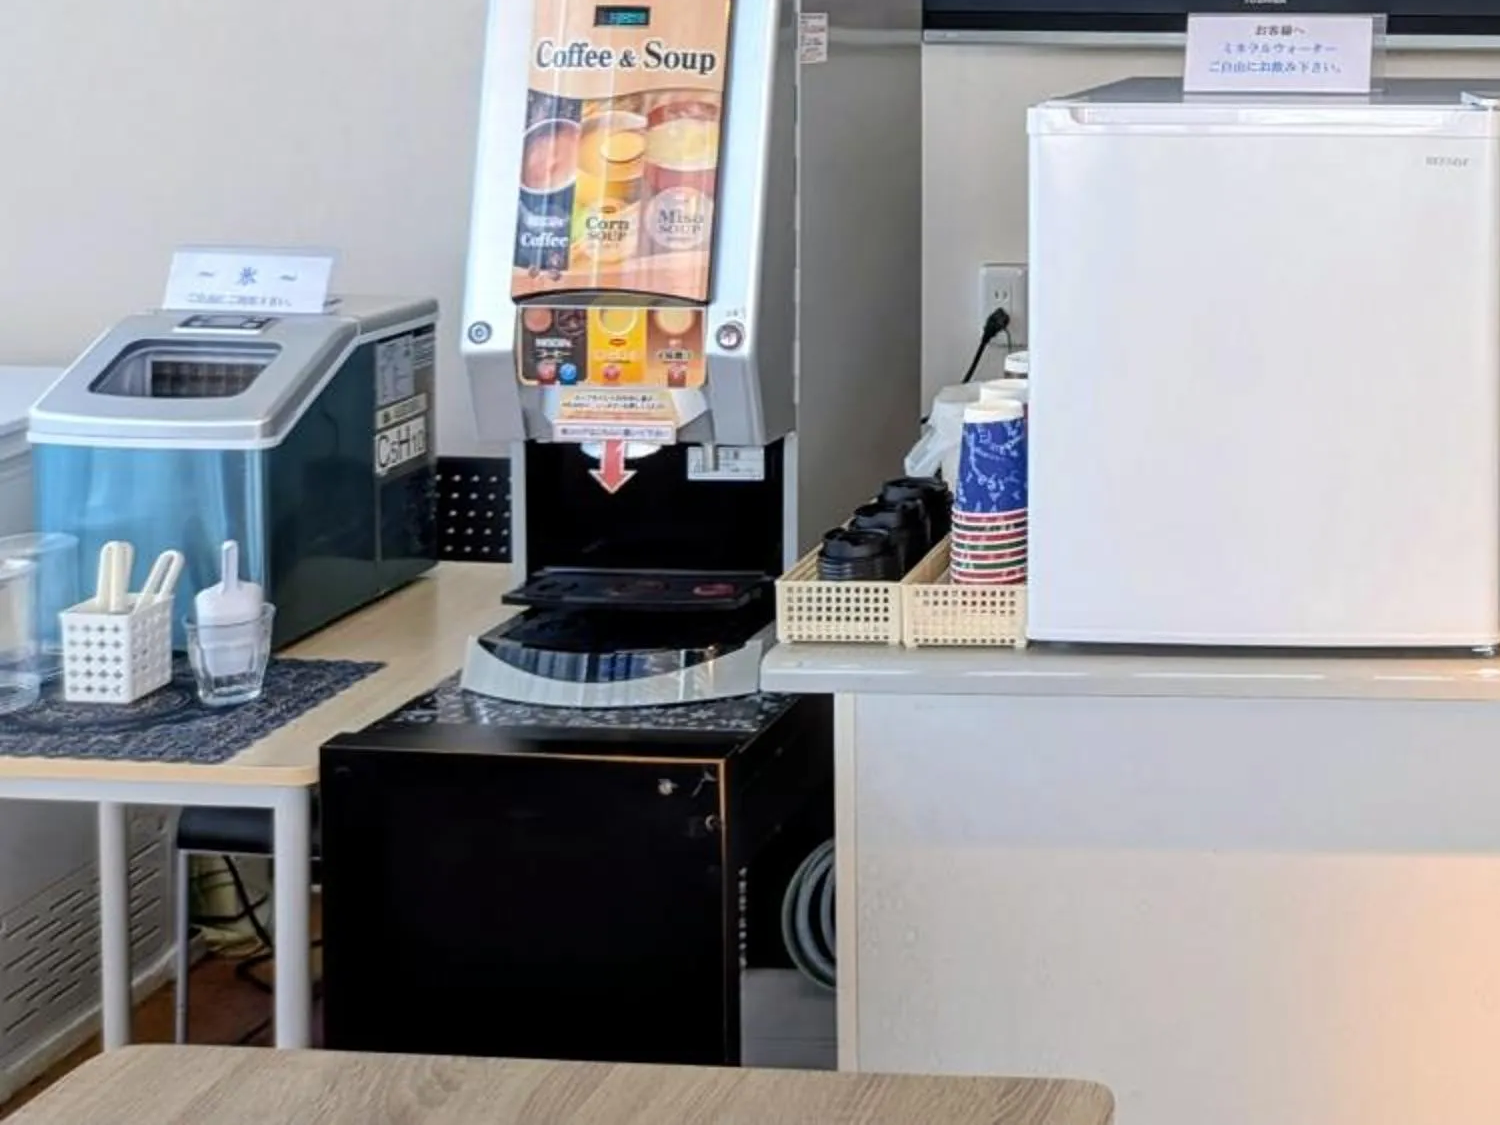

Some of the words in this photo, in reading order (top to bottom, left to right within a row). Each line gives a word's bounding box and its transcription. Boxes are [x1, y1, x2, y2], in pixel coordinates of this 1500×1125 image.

[536, 40, 613, 68] Coffee
[618, 49, 637, 68] &
[644, 40, 716, 75] Soup
[585, 216, 630, 231] Corn
[519, 231, 570, 248] Coffee
